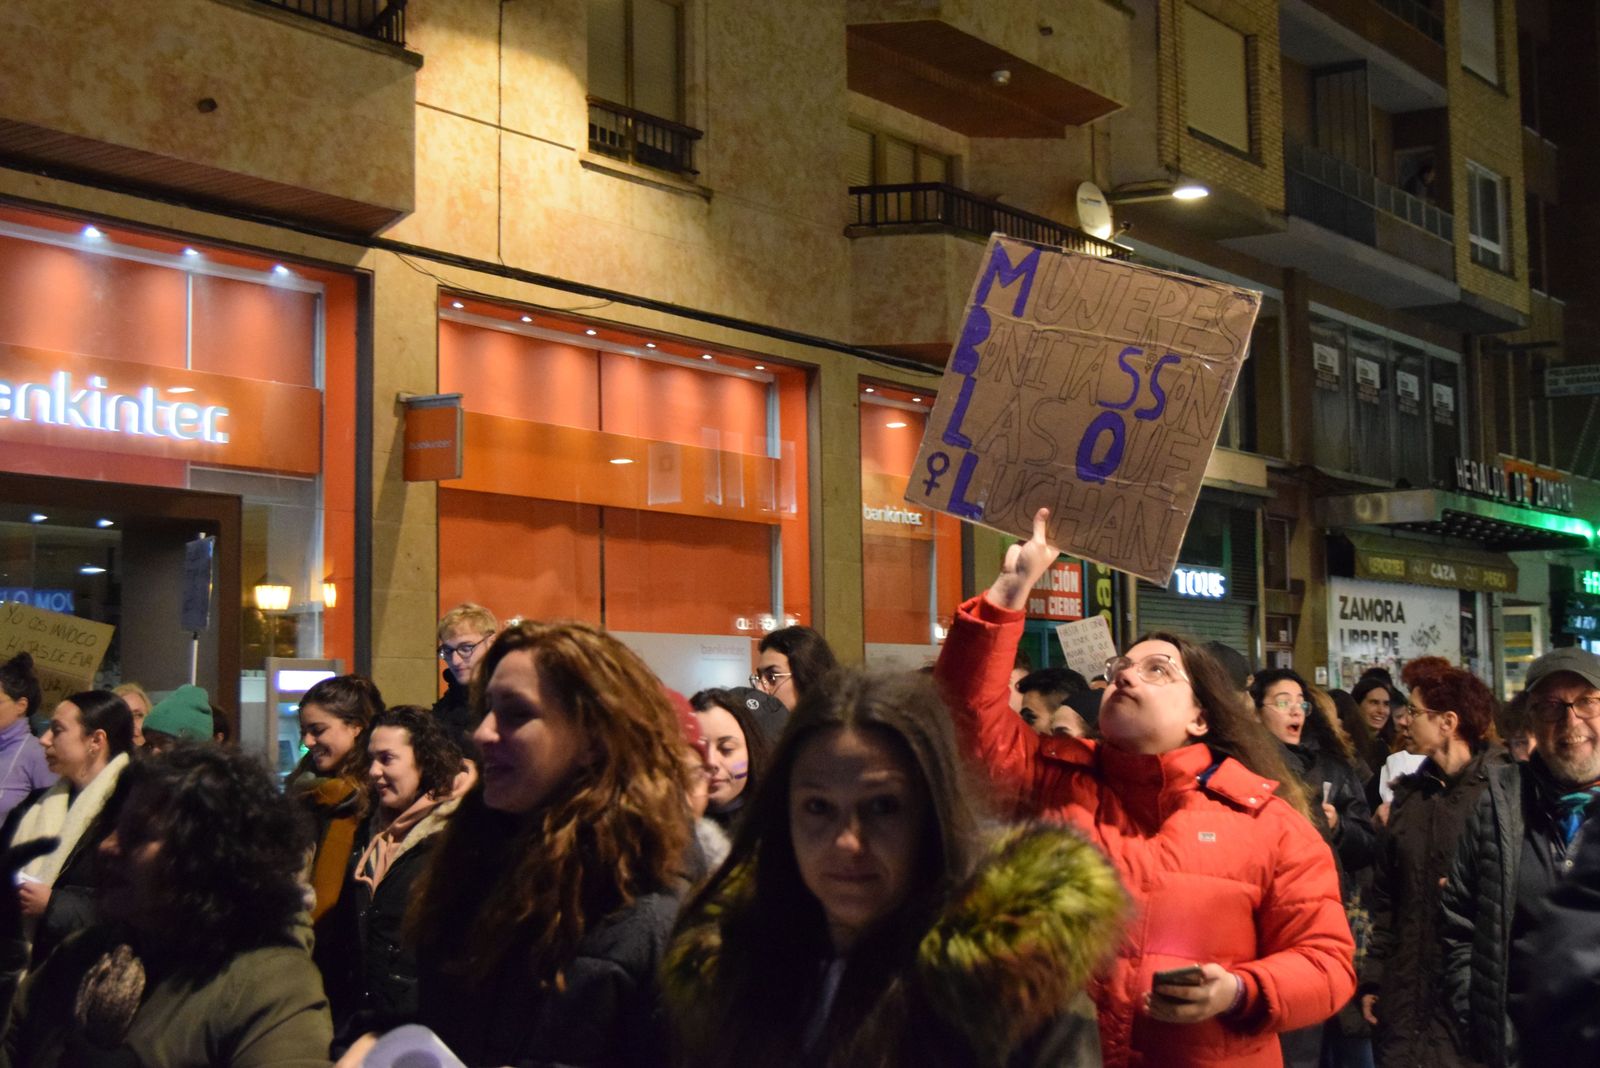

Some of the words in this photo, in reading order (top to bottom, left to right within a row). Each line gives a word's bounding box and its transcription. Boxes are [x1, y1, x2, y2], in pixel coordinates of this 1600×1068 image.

[975, 241, 1242, 364] MUJERES
[952, 304, 1140, 411] BONITAS
[1134, 354, 1233, 440] SON
[942, 375, 1068, 467] LAS
[1076, 410, 1200, 505] QUE
[863, 503, 922, 526] bankinter
[947, 452, 1184, 574] LUCHAN
[1430, 562, 1457, 582] CAZA
[5, 606, 24, 625] YO
[1049, 595, 1083, 618] CIERRE
[1339, 596, 1406, 624] ZAMORA
